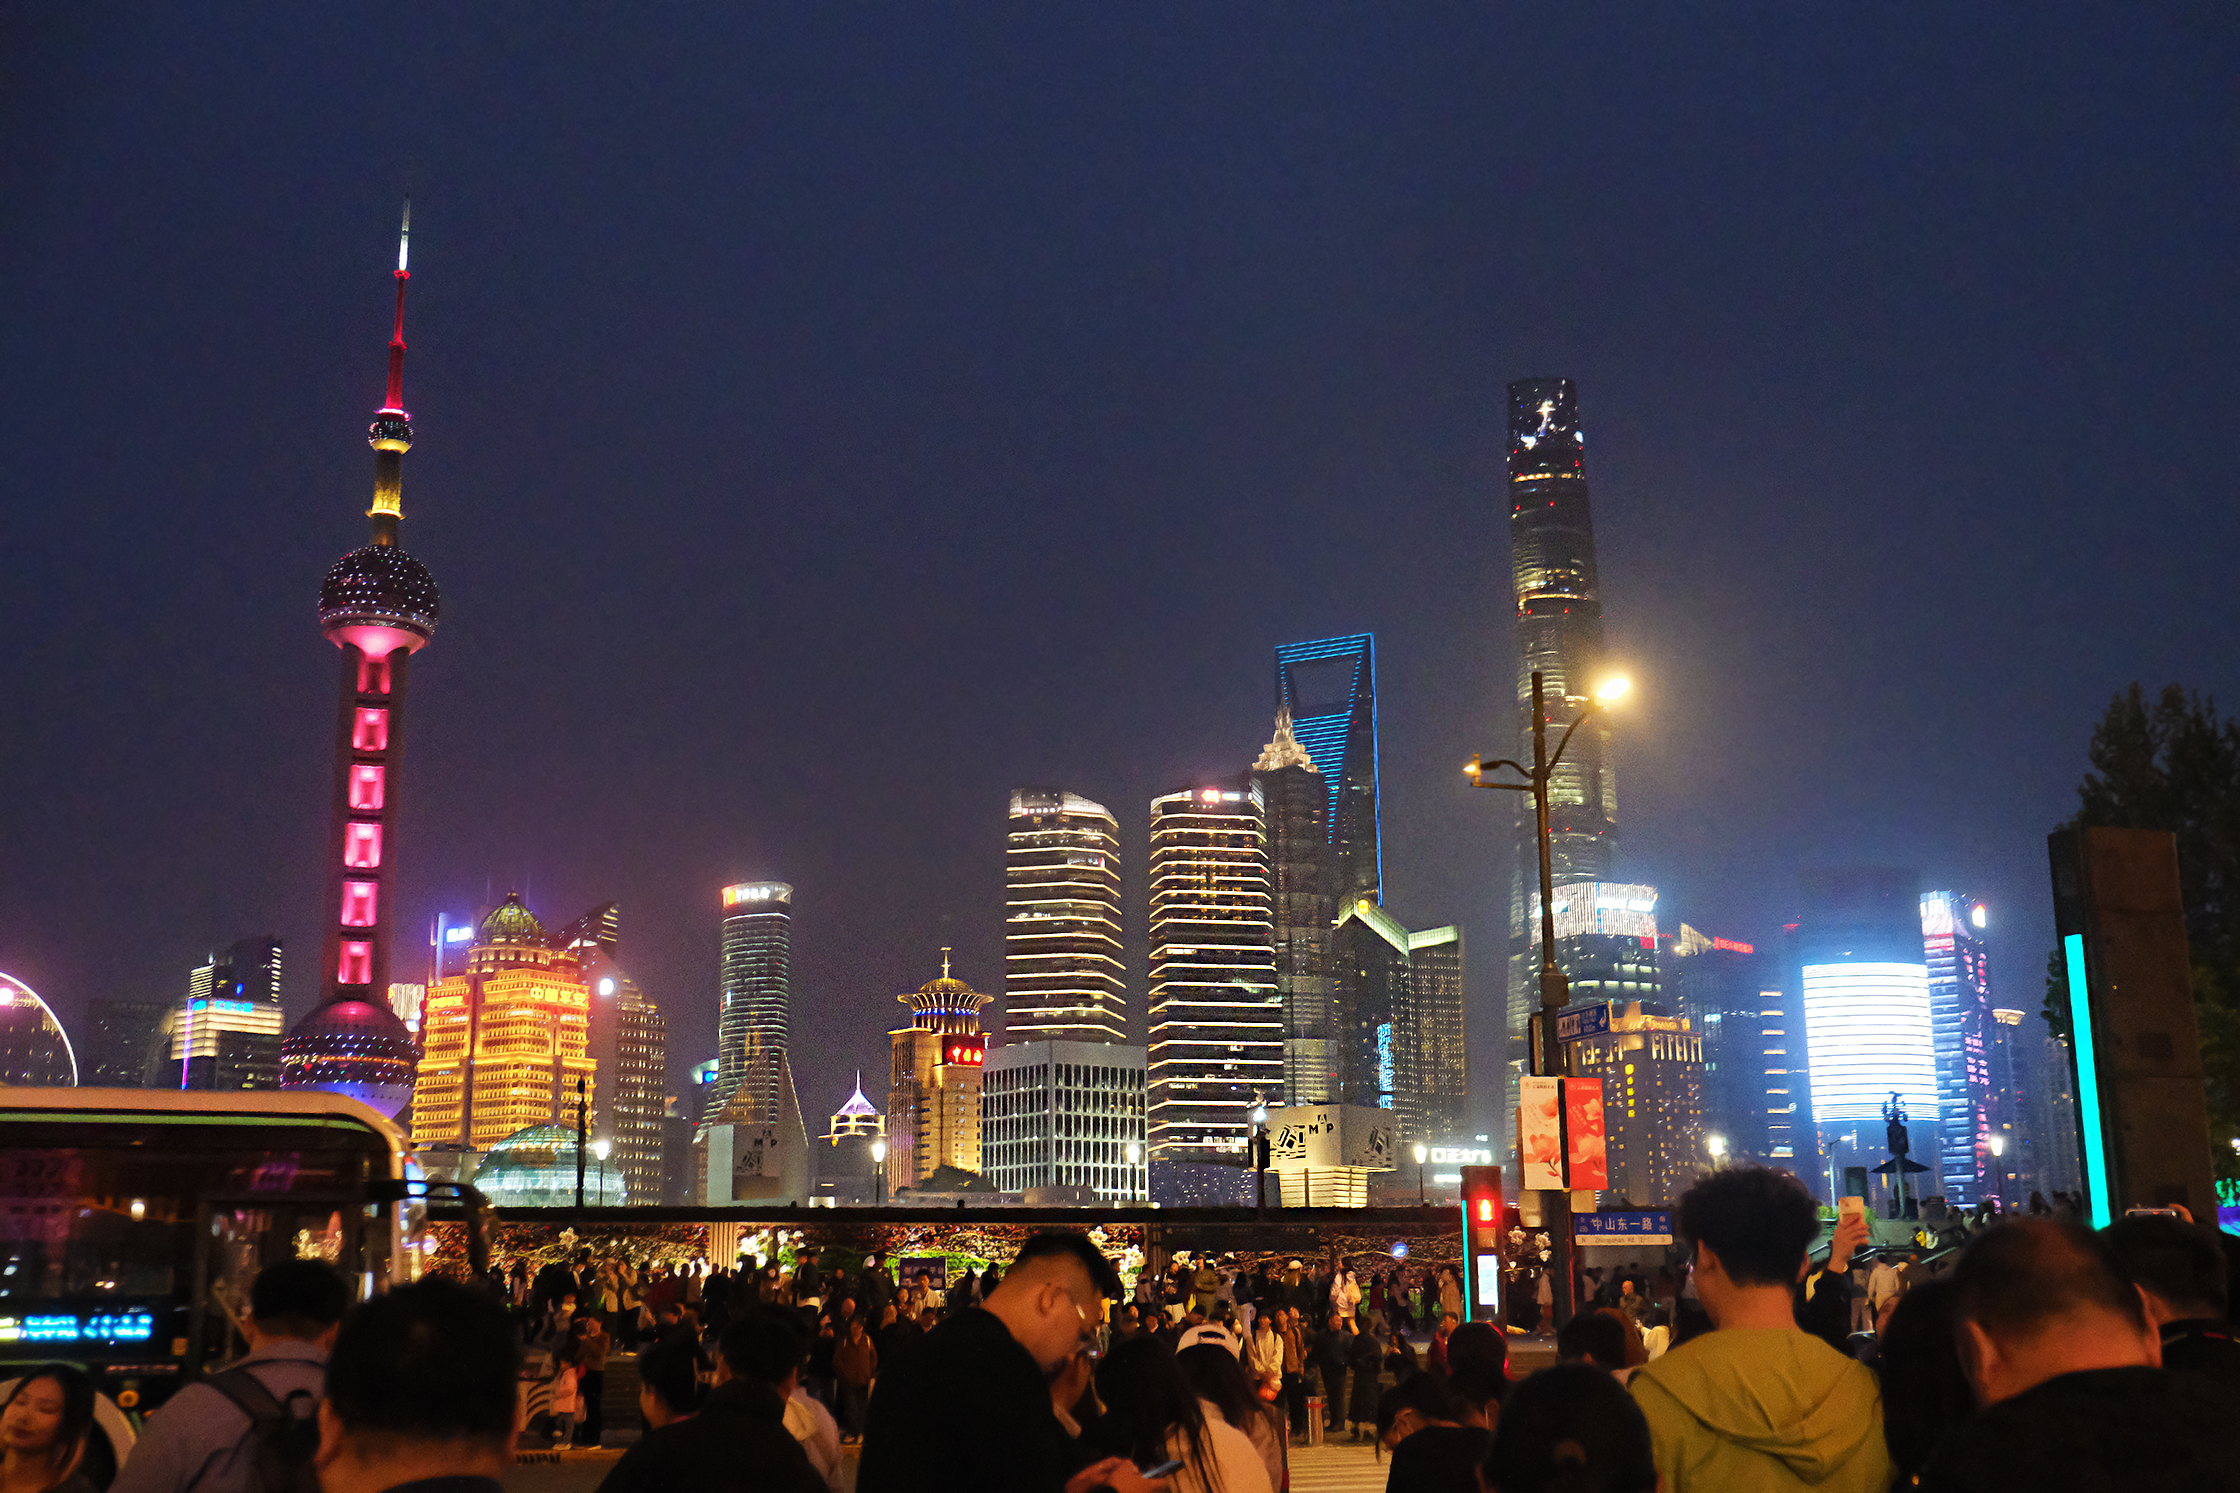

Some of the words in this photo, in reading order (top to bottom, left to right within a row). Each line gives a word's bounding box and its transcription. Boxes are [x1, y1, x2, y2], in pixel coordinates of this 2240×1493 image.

[530, 987, 587, 1006] 中国平安
[1308, 1113, 1334, 1135] MAP
[1590, 1216, 1653, 1232] 中山东一路
